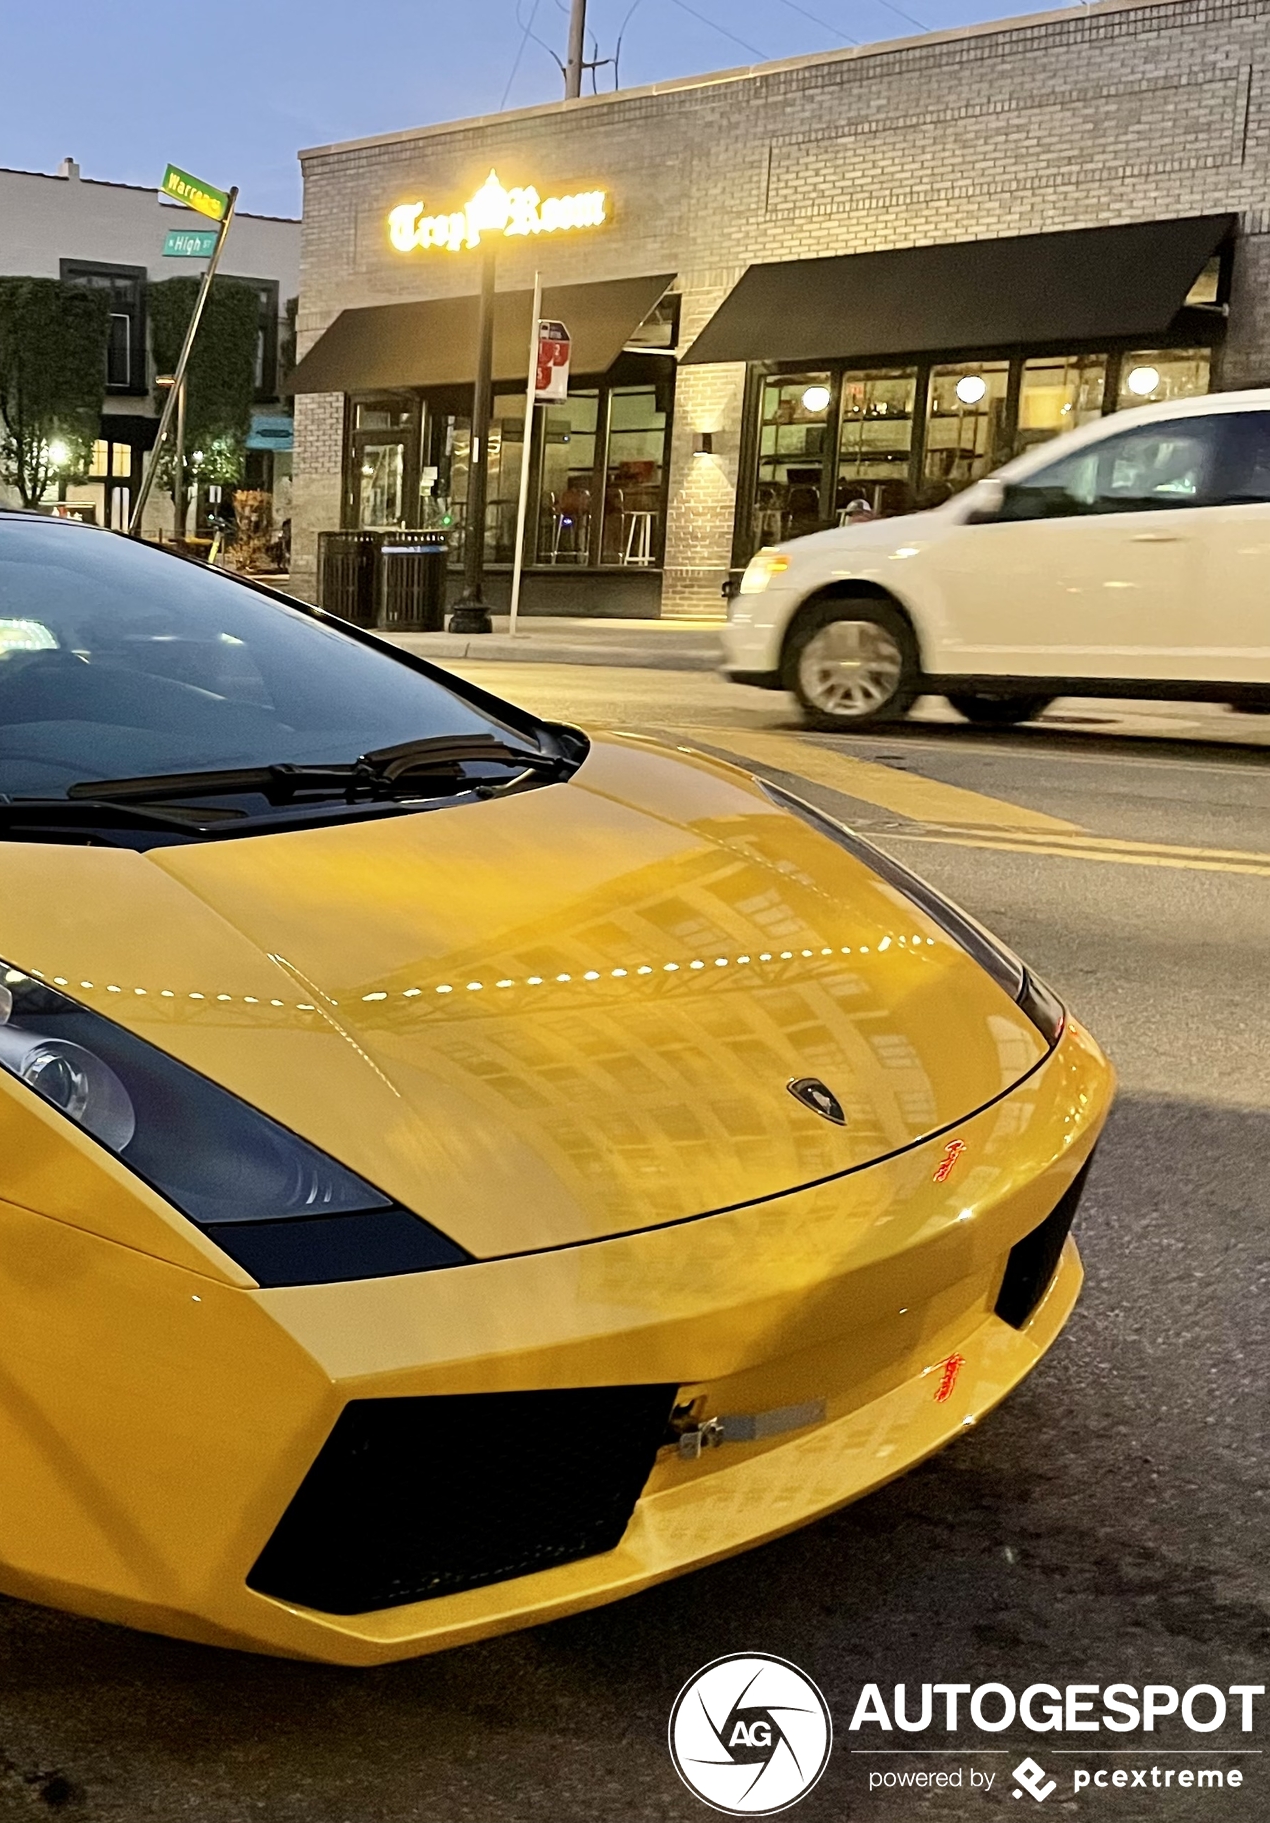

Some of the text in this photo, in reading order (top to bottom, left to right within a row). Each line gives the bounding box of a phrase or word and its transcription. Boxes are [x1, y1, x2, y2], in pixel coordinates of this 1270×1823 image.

[168, 172, 210, 207] Warren
[503, 185, 606, 237] Room
[174, 236, 201, 255] High
